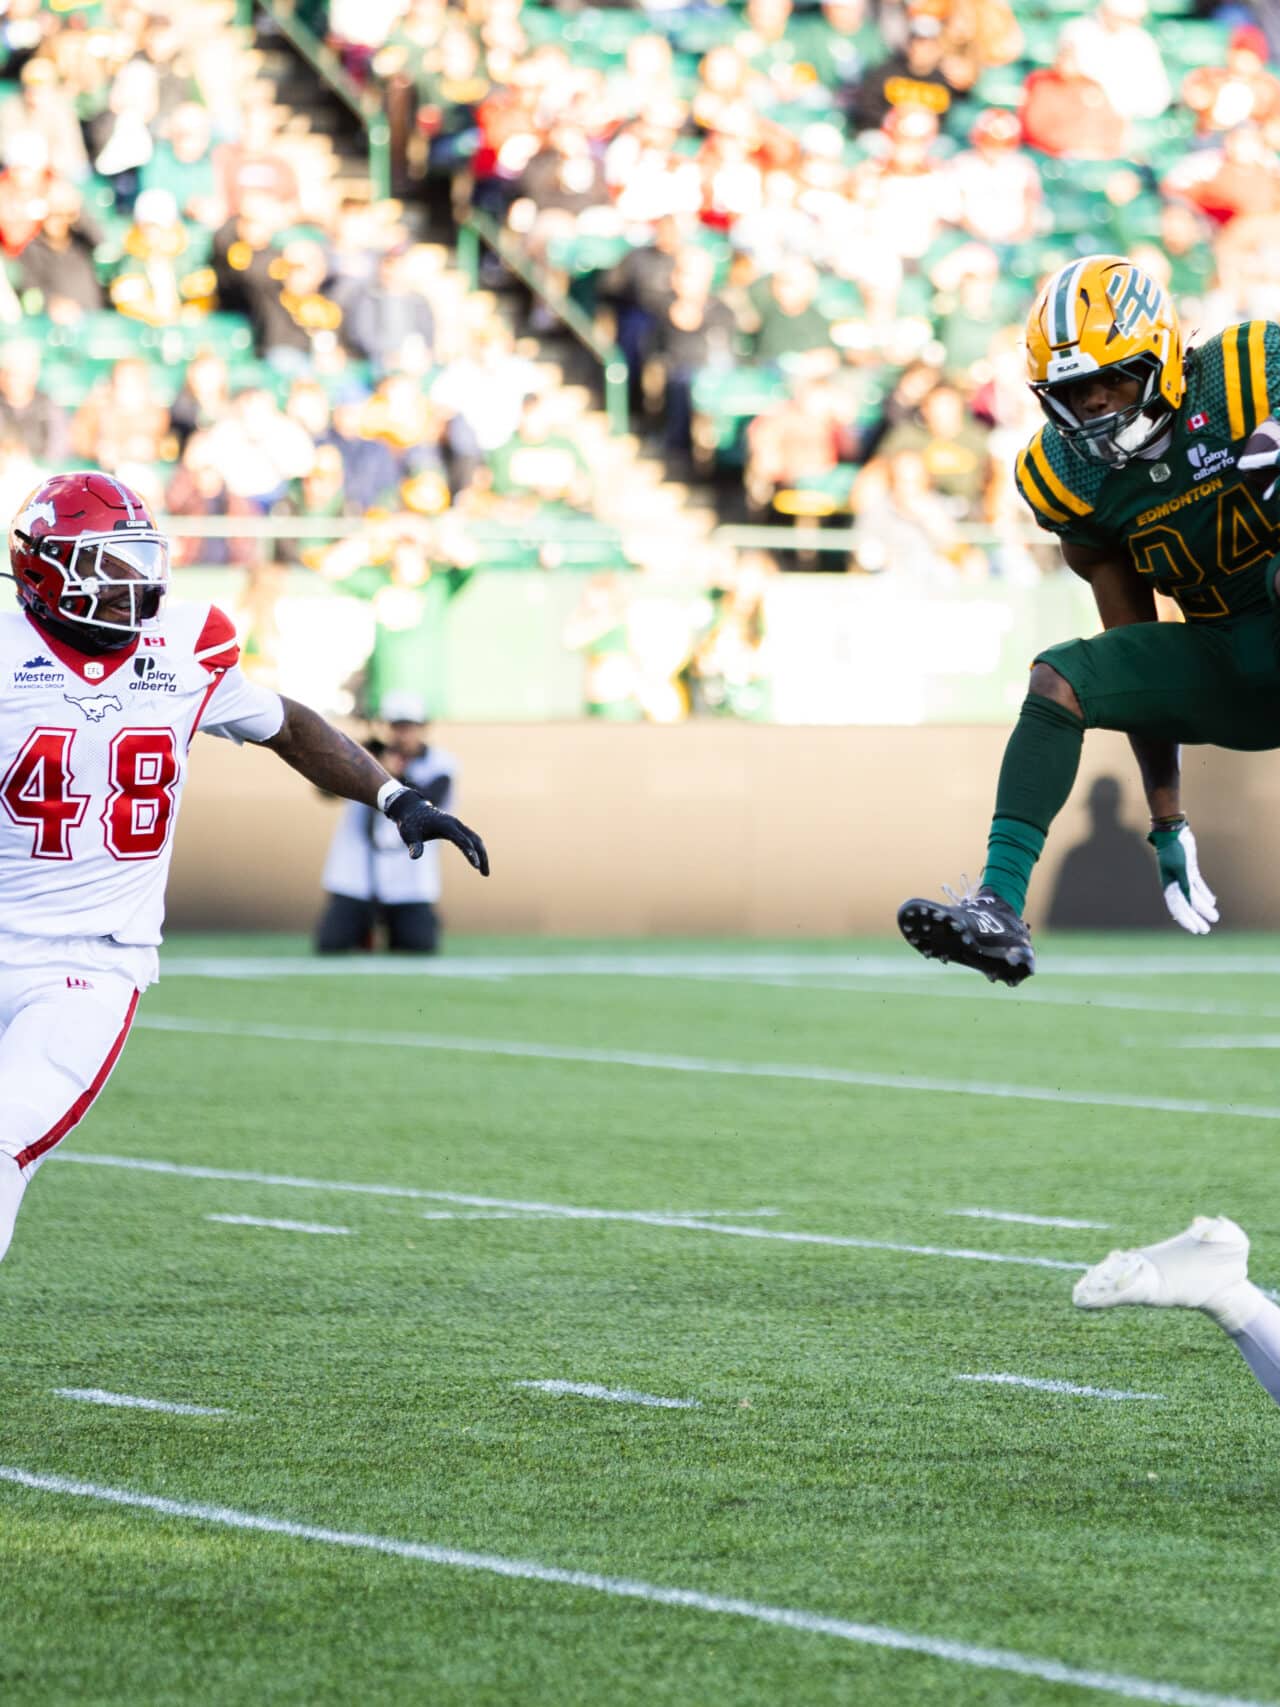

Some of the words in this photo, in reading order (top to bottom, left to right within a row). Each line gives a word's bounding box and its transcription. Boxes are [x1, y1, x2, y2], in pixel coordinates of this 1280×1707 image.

[1203, 448, 1229, 467] play
[1193, 455, 1235, 481] alberta
[1136, 478, 1224, 526] EDMONTON
[14, 671, 65, 683] Western
[147, 670, 176, 682] play
[129, 680, 177, 692] alberta
[0, 726, 181, 861] 48
